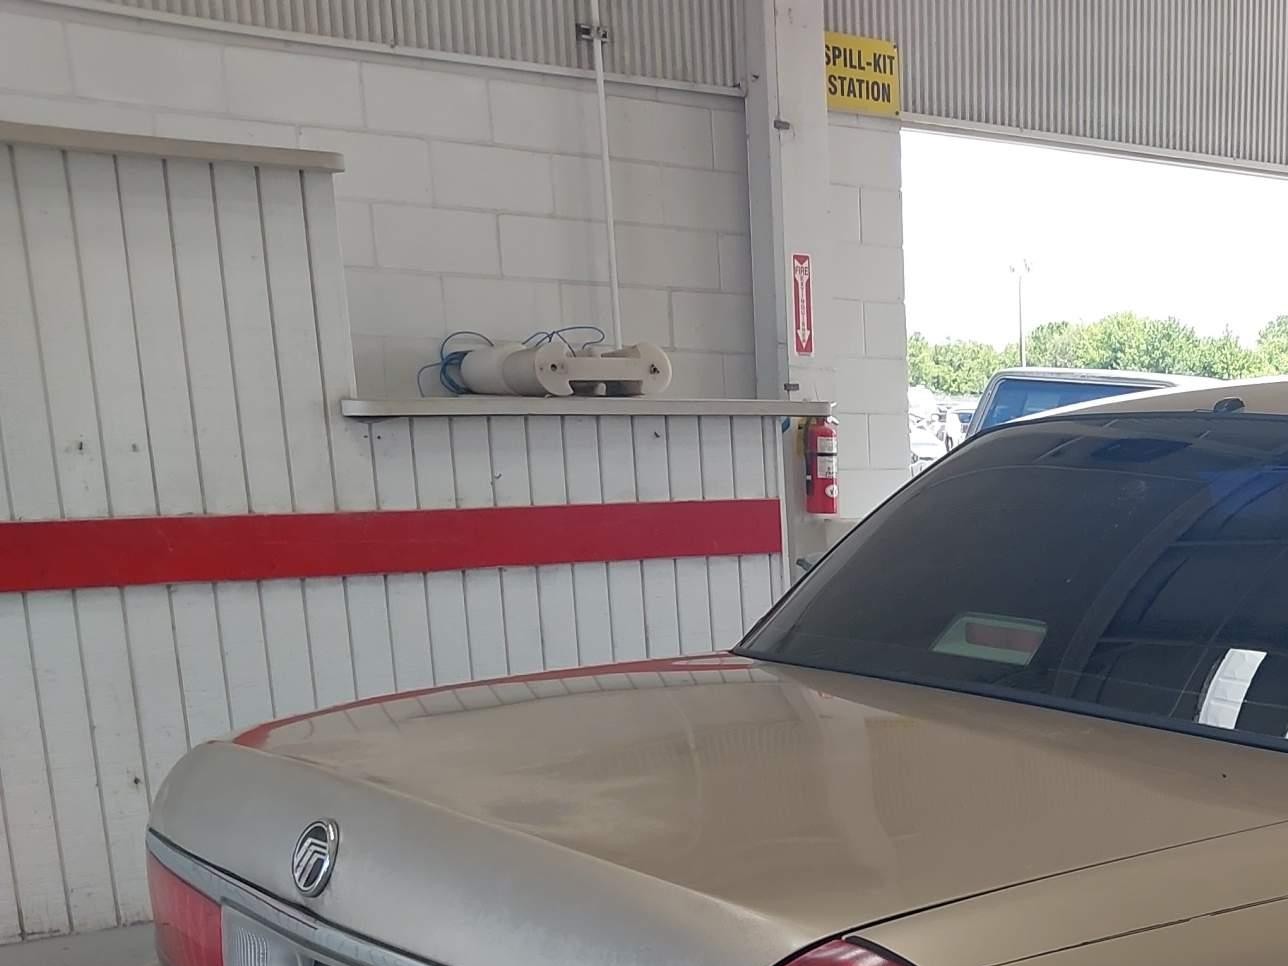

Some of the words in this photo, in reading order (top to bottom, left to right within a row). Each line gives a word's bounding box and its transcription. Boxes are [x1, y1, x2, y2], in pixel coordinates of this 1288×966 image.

[825, 44, 895, 75] SPILL-KIT
[828, 74, 891, 103] STATION
[795, 266, 808, 276] FIRE
